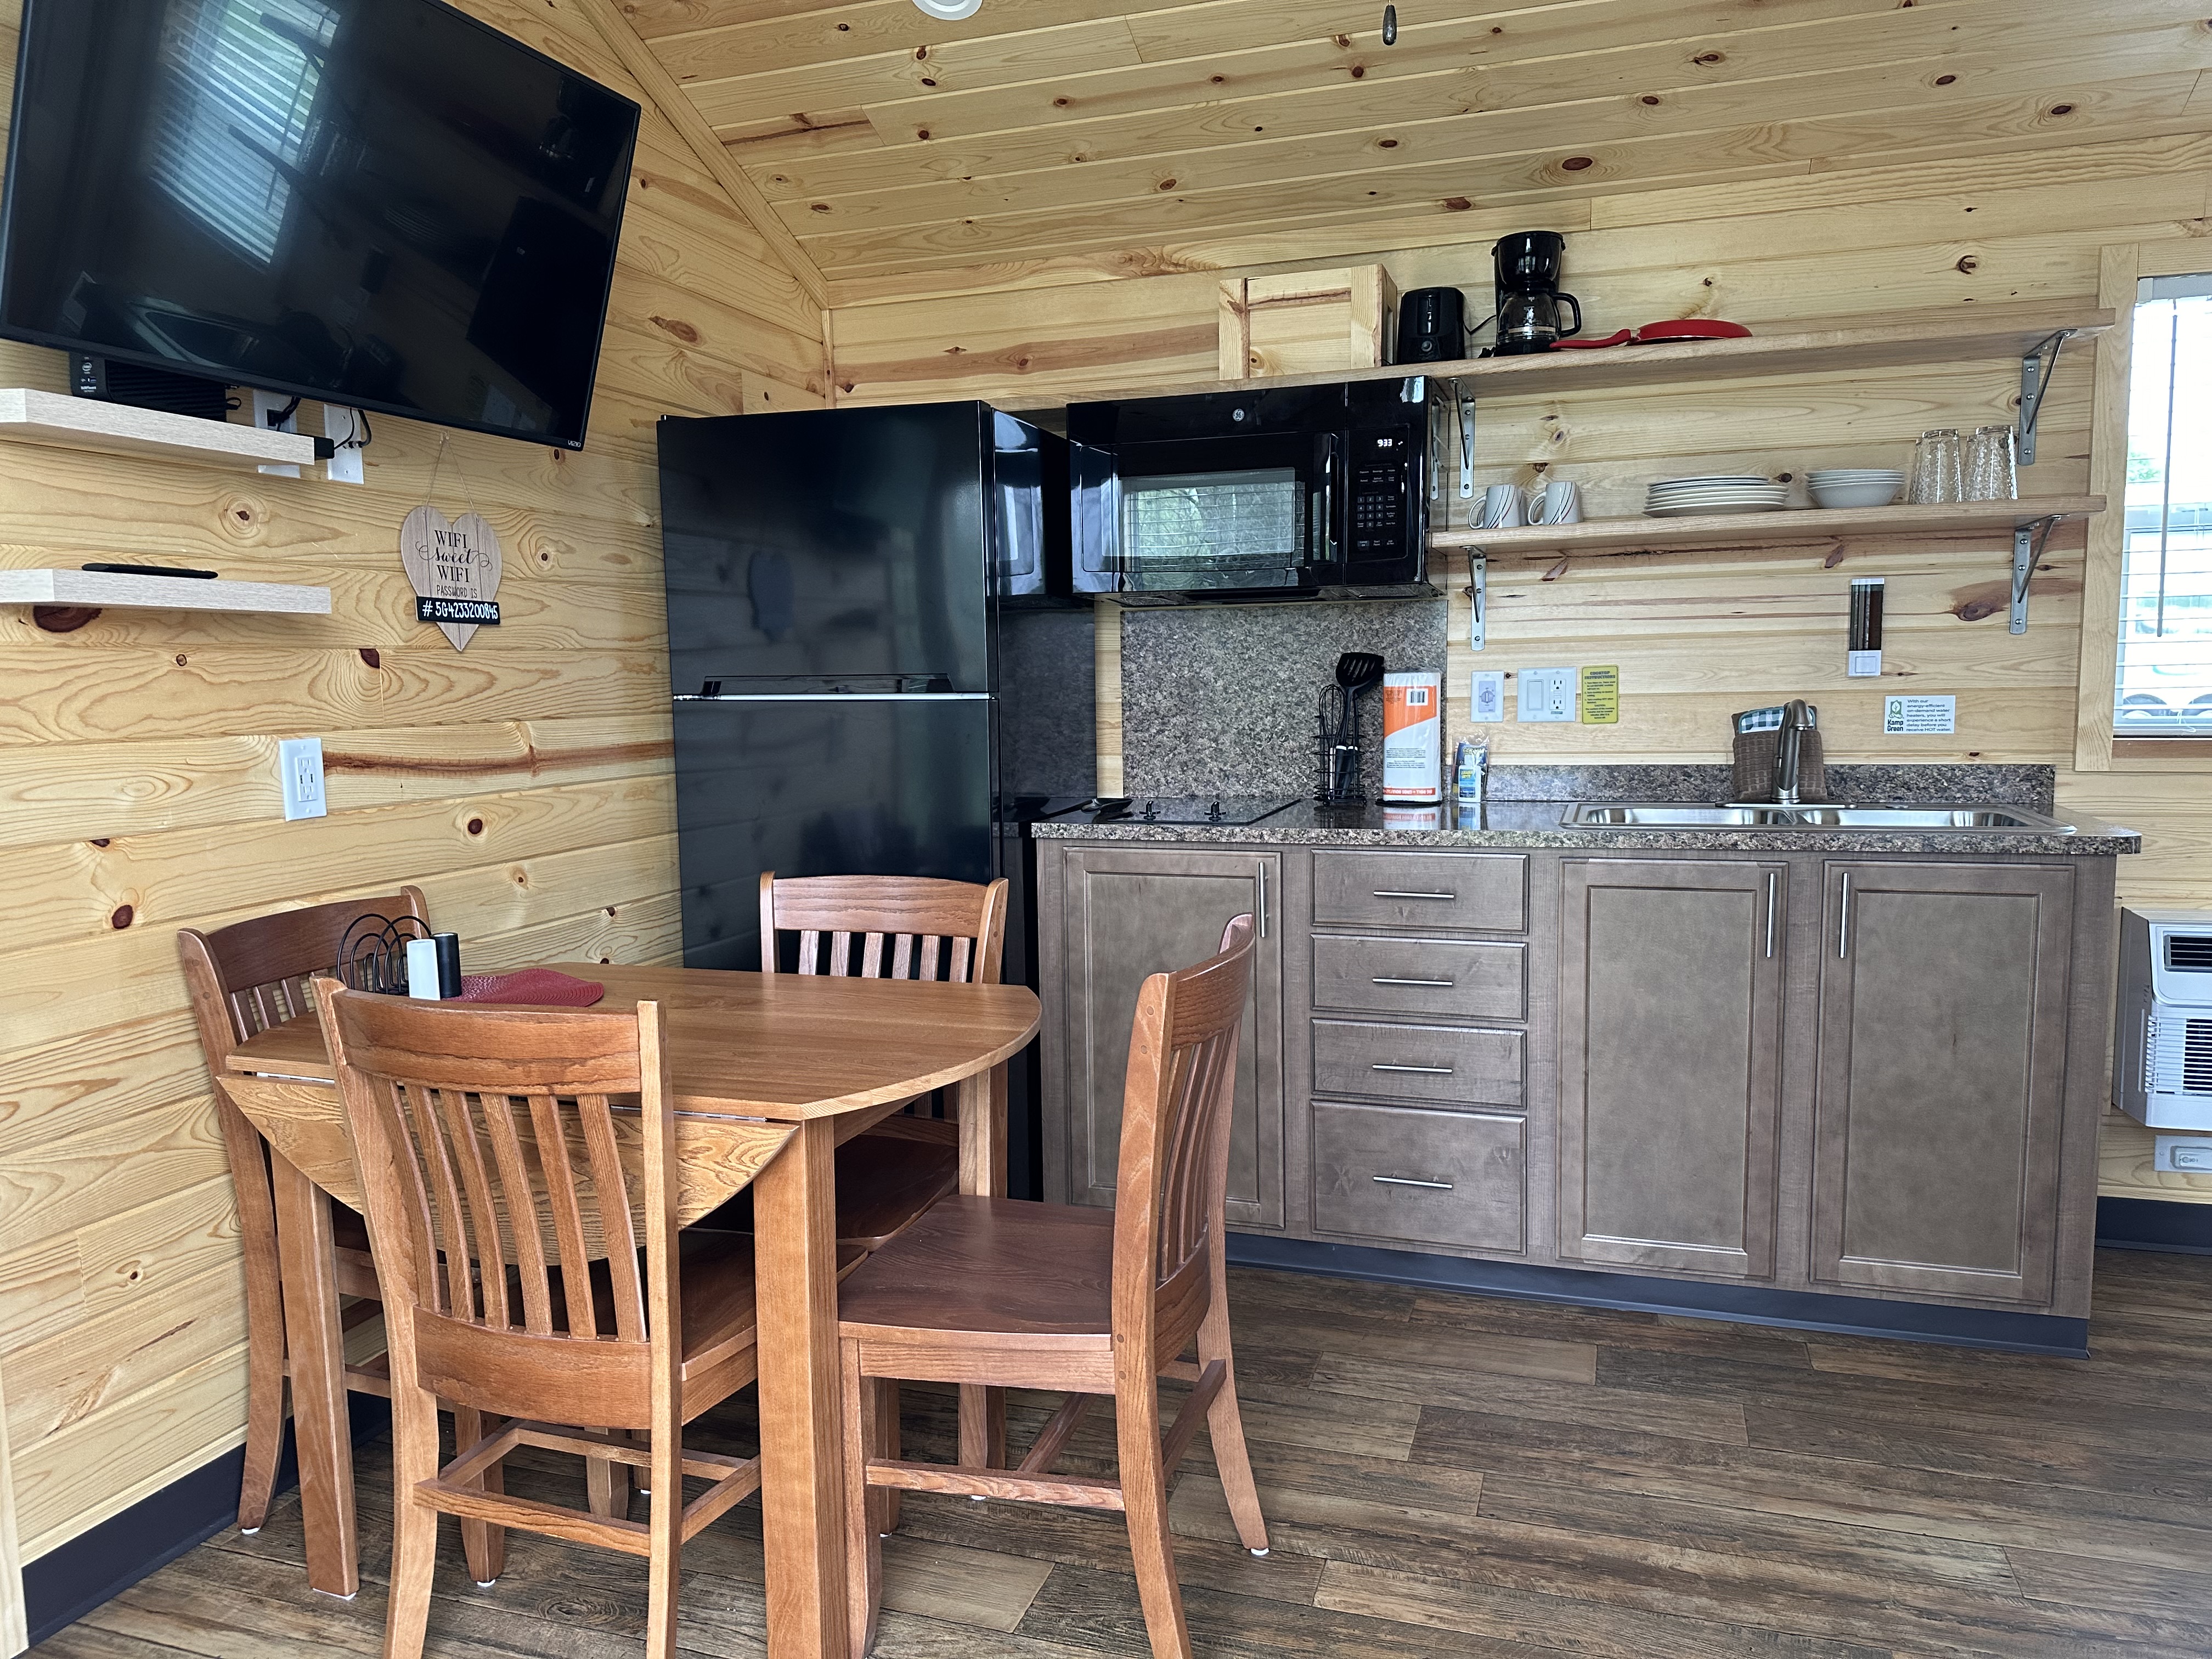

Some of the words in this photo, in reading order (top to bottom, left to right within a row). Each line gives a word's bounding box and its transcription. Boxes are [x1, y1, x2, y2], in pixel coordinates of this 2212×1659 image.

[434, 529, 467, 549] WIFI
[437, 565, 470, 583] WIFI
[437, 584, 467, 597] PASSWORD
[470, 588, 477, 599] IS
